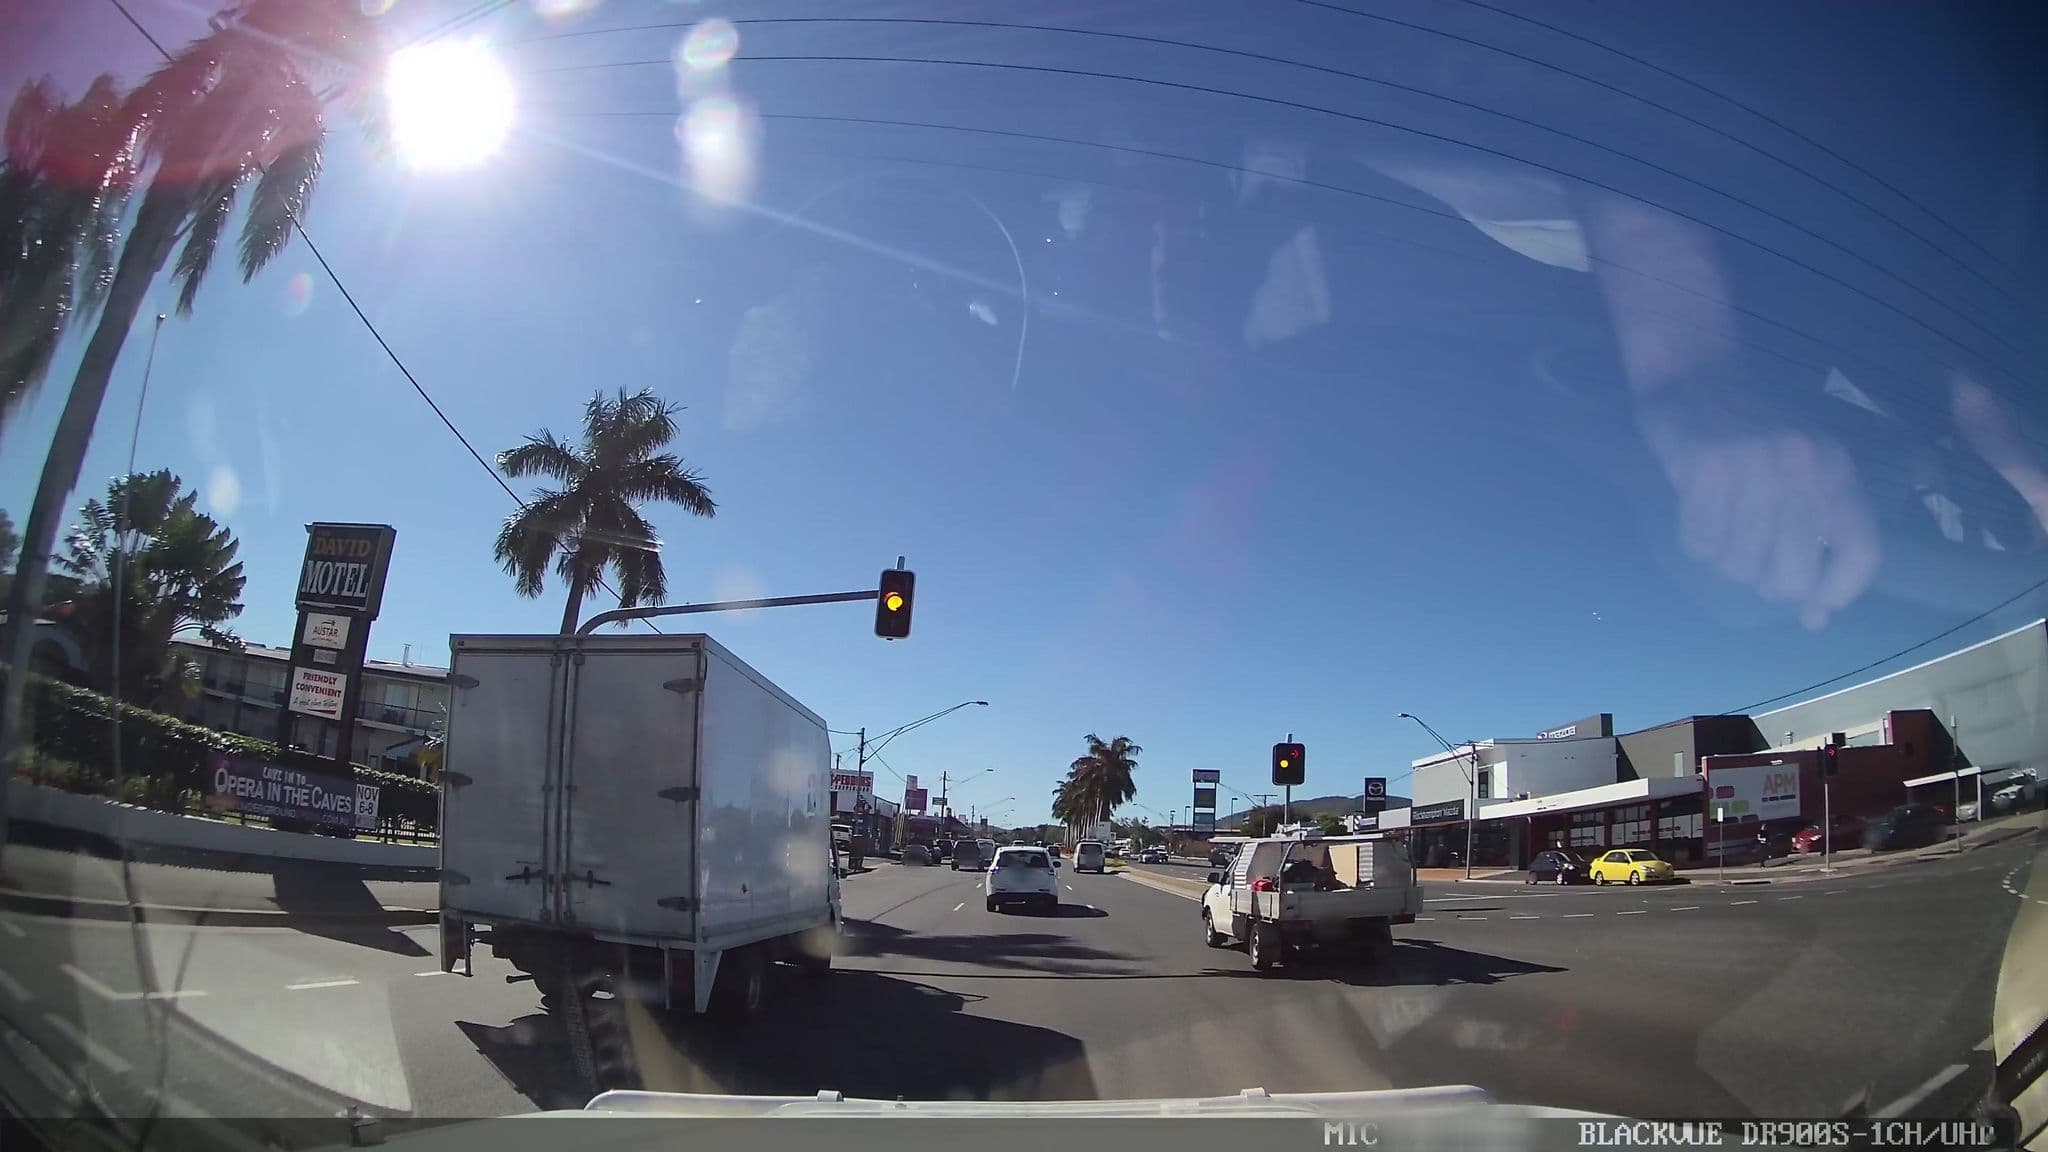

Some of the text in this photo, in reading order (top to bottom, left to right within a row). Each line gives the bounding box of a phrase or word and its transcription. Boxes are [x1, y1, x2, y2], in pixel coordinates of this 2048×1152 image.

[312, 537, 370, 557] DAVID
[301, 560, 368, 597] MOTEL
[312, 626, 339, 638] AUSTAR
[303, 672, 338, 685] FRIENDLY
[296, 682, 342, 698] CONVENIENT
[214, 767, 352, 813] OPERA IN THE CAVES
[1763, 772, 1796, 795] APM
[357, 785, 380, 800] NOV
[358, 802, 374, 814] 6-8
